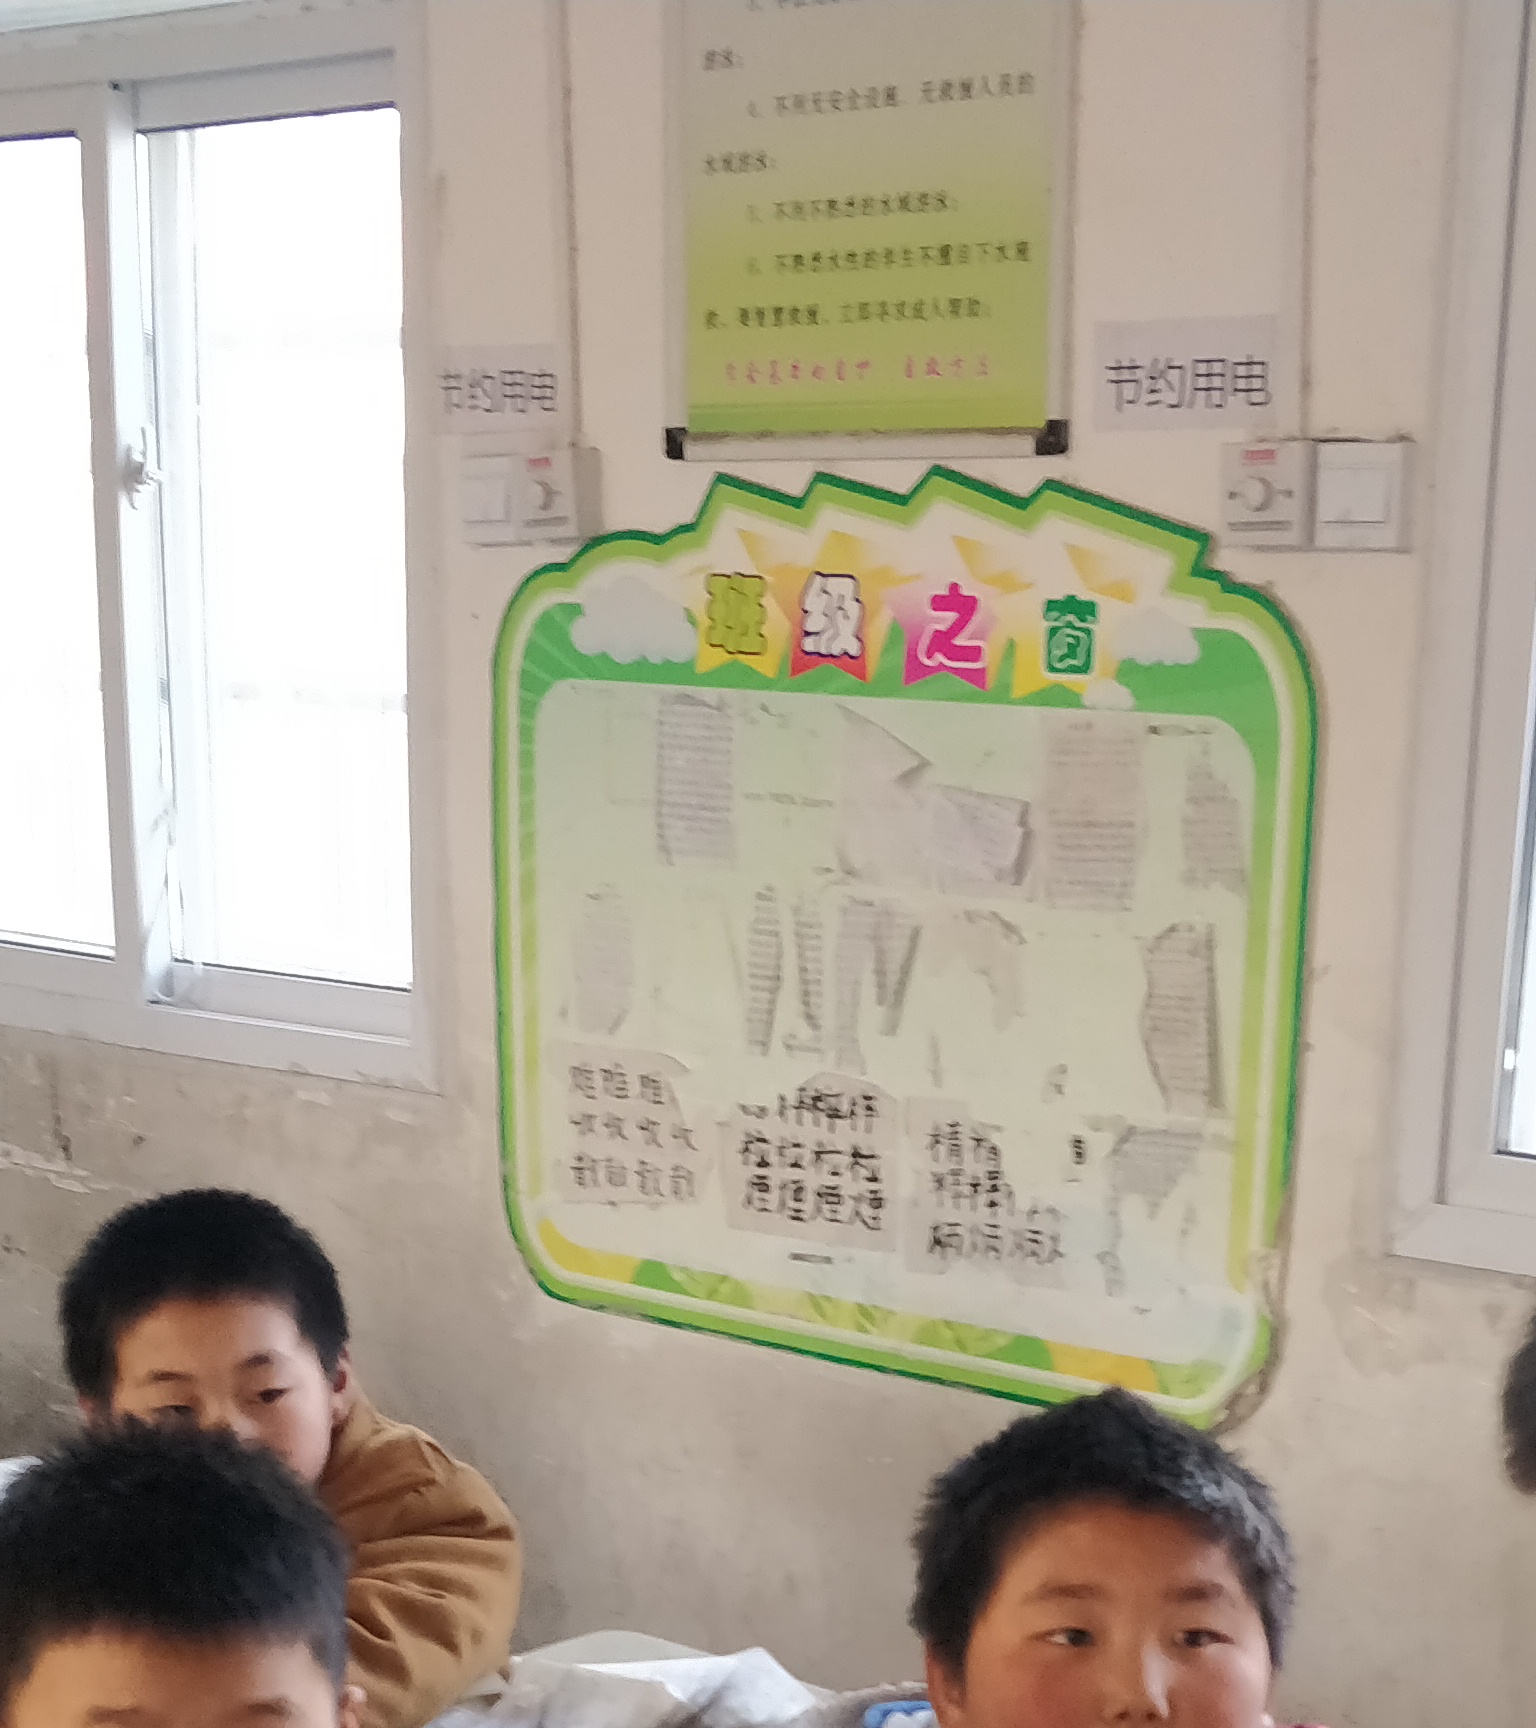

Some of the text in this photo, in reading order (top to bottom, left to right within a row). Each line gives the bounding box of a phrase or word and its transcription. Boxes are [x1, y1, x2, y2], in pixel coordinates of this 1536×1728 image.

[437, 367, 558, 415] 节约用电
[1104, 356, 1272, 412] 节约用电
